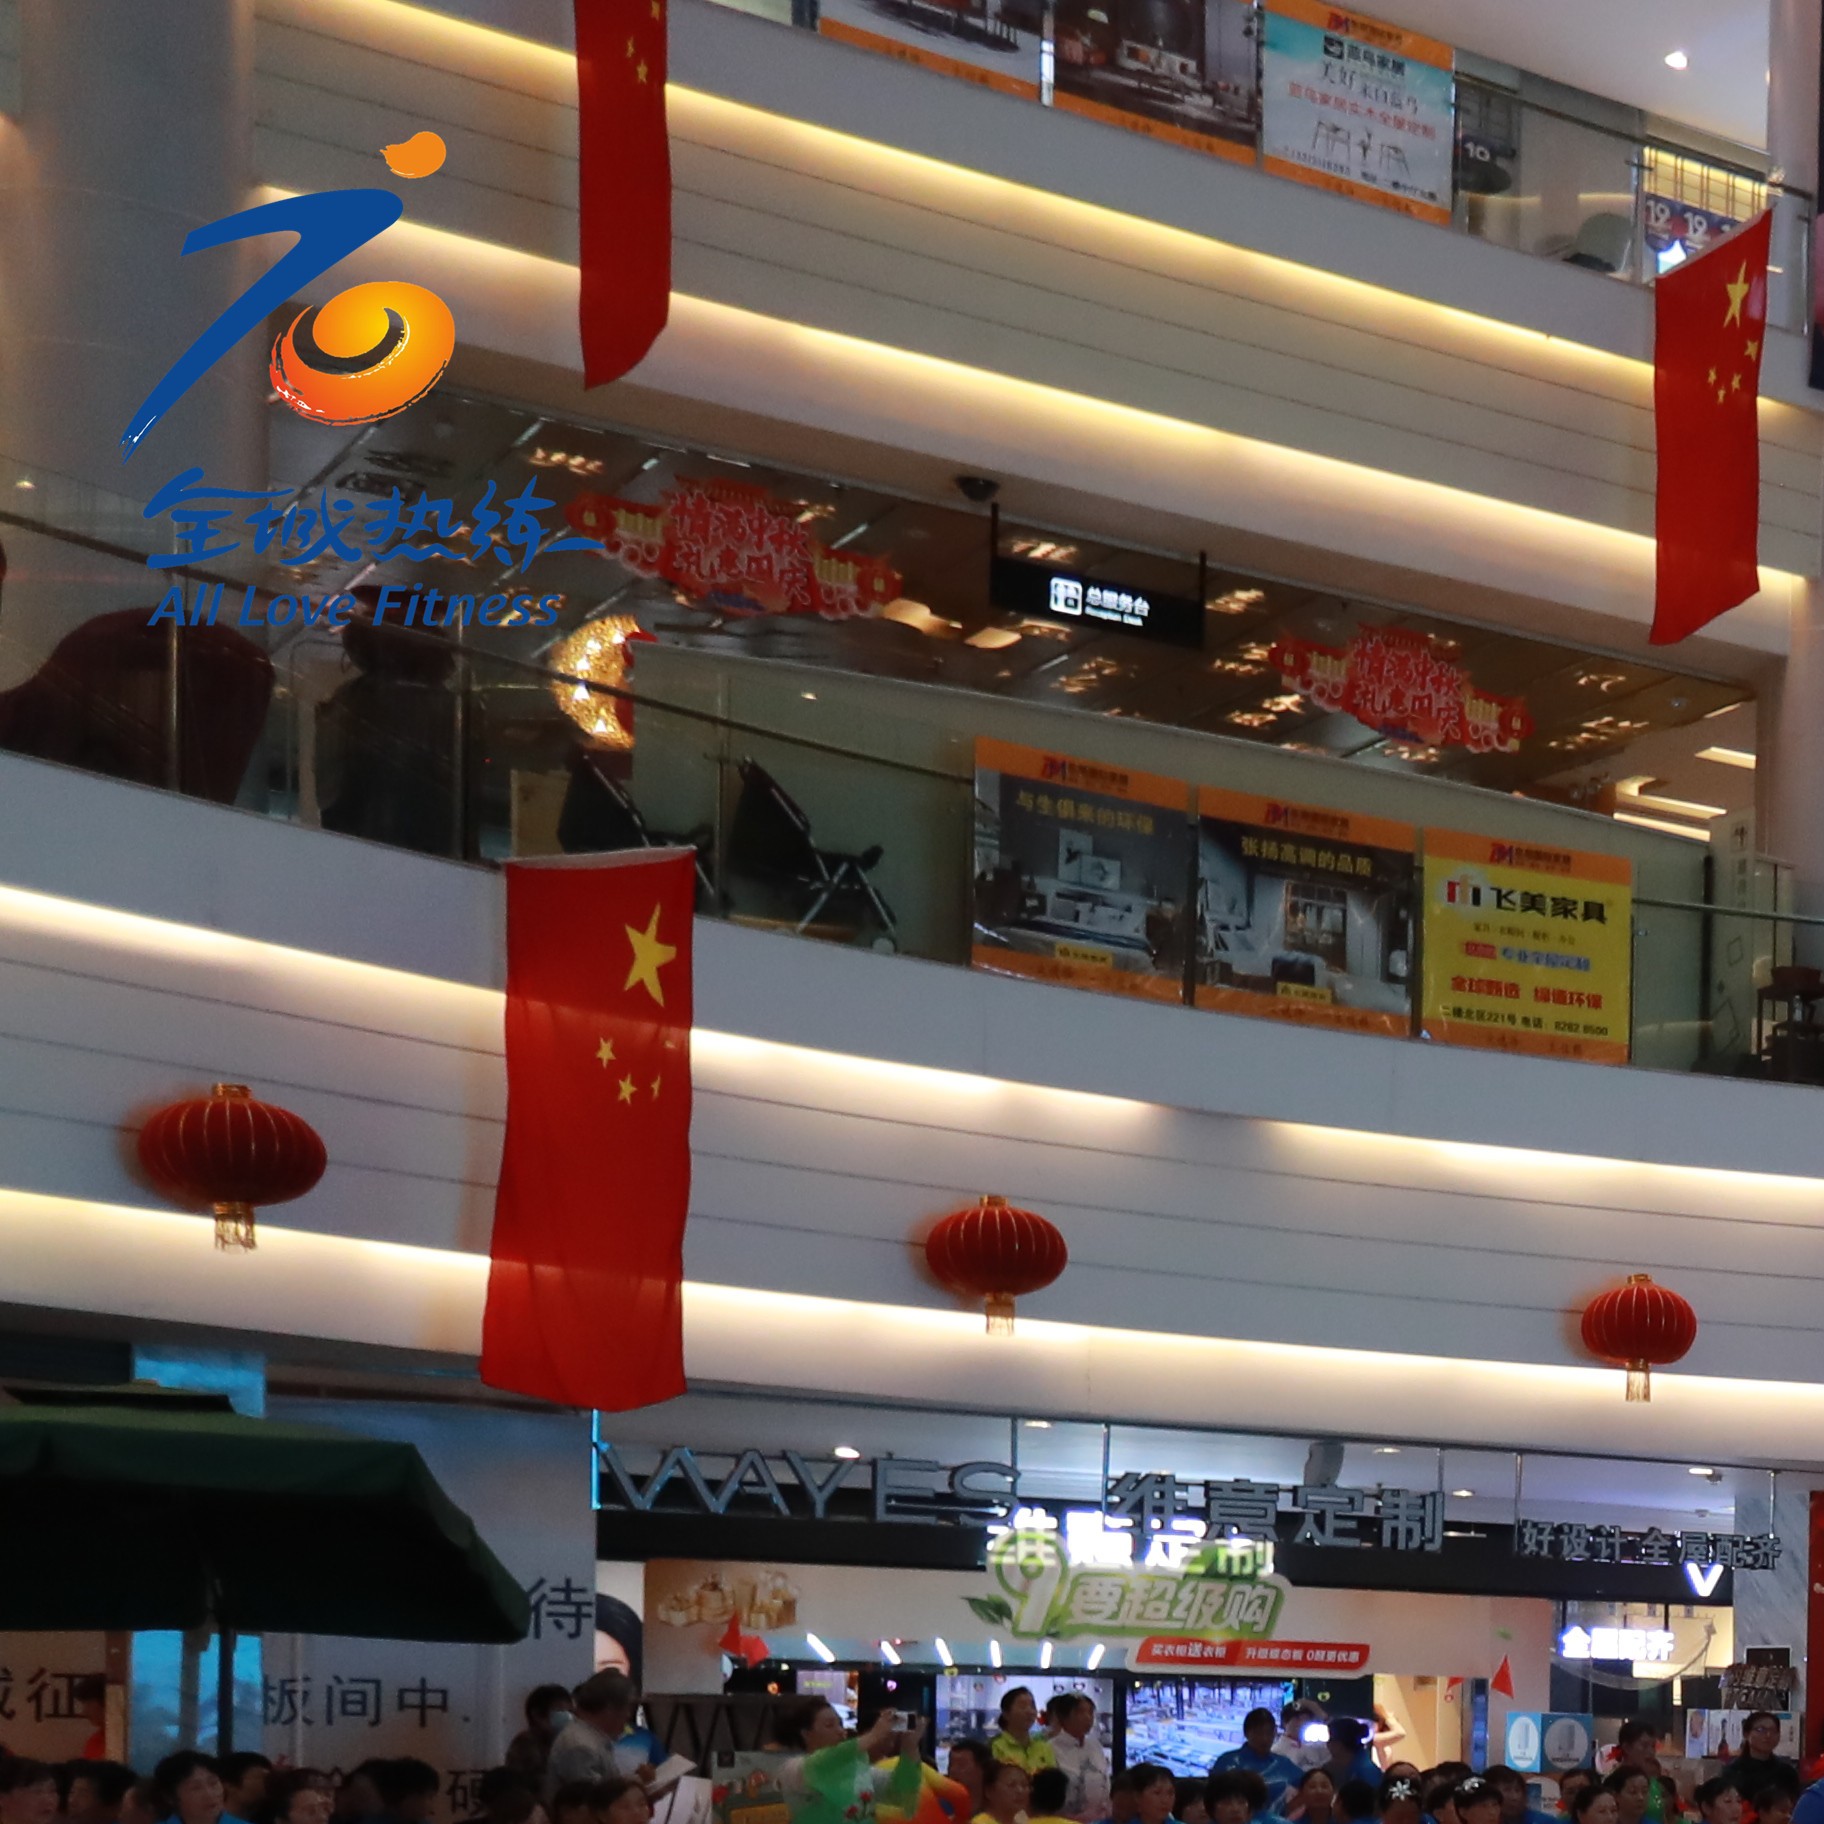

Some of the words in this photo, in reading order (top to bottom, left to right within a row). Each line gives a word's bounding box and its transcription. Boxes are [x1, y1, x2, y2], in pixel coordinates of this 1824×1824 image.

[1085, 585, 1151, 618] 总服务台
[1241, 836, 1373, 878] 张扬高调的品质
[1490, 886, 1608, 925] 飞美家具
[599, 1444, 1022, 1528] WAYES
[1102, 1470, 1446, 1553] 维意定制
[1520, 1517, 1632, 1564] 好设计
[1639, 1526, 1783, 1571] 全屋配齐
